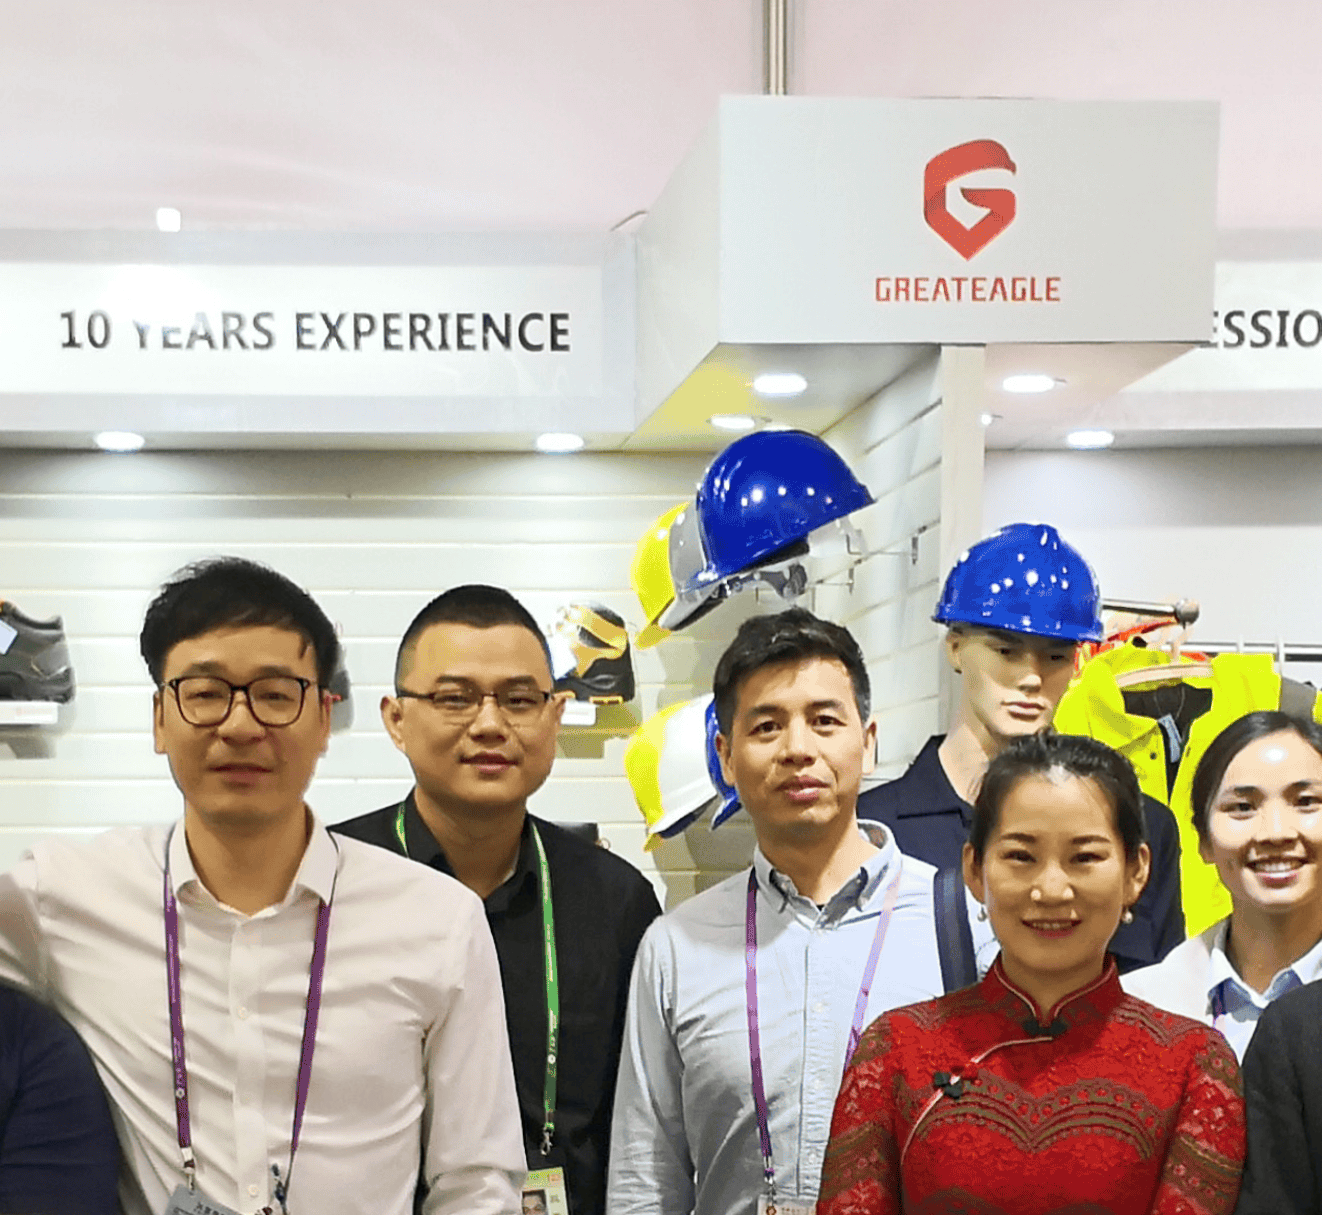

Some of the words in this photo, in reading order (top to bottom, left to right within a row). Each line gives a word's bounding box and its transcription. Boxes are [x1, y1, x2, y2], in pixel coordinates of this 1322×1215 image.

[874, 276, 1062, 303] GREATEAGLE
[60, 310, 111, 349] 10
[133, 310, 275, 351] YEARS
[295, 312, 572, 353] EXPERIENCE
